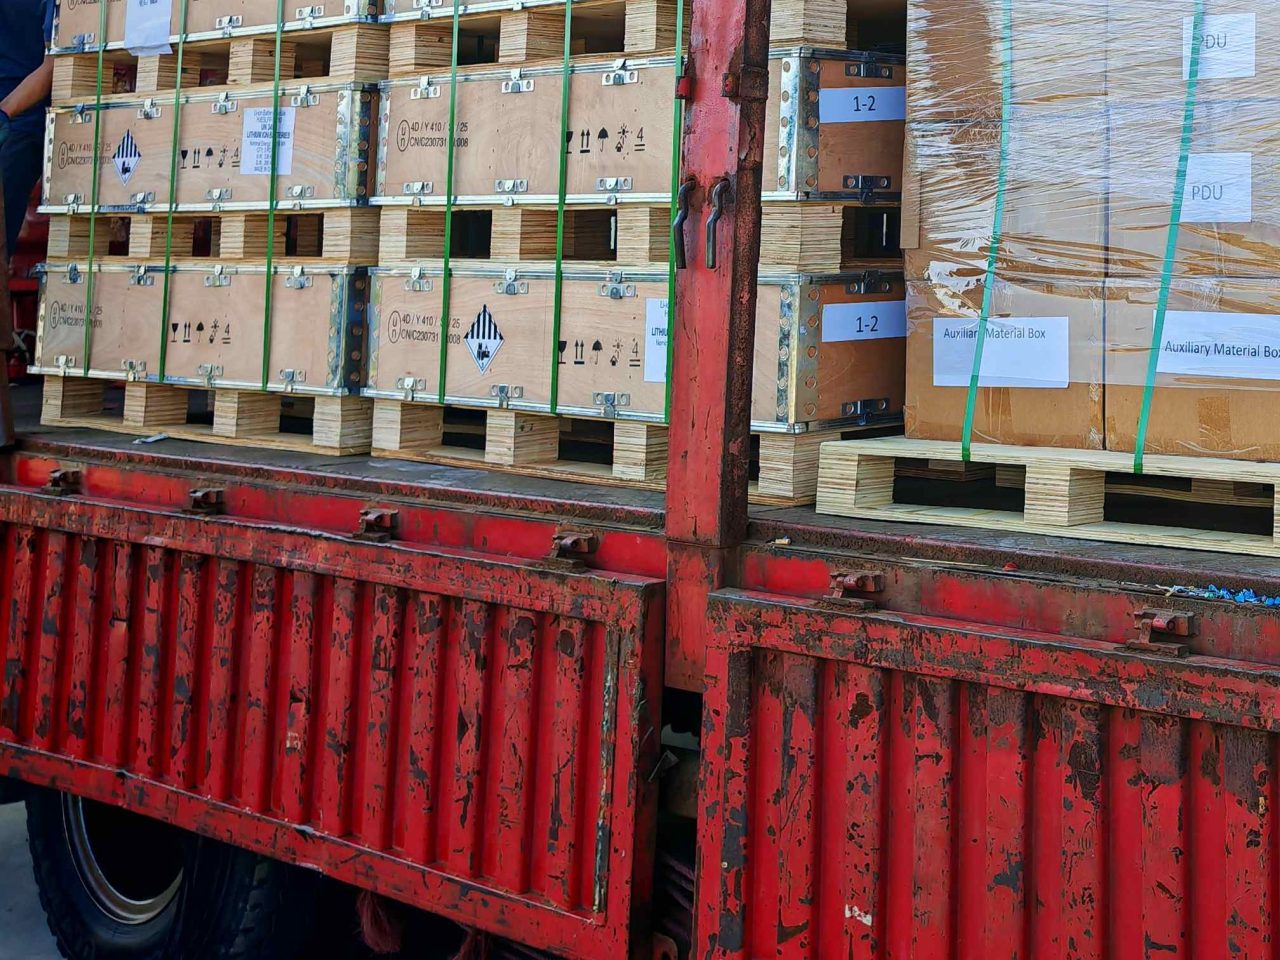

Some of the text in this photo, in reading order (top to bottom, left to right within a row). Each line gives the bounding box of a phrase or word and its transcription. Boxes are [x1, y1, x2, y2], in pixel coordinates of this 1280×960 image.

[854, 95, 876, 112] 1-2
[1192, 184, 1223, 201] PDU
[856, 315, 879, 333] 1-2
[944, 328, 1046, 340] Auxiliar Material Box
[1165, 340, 1211, 357] Auxiliary
[1214, 343, 1260, 357] Material
